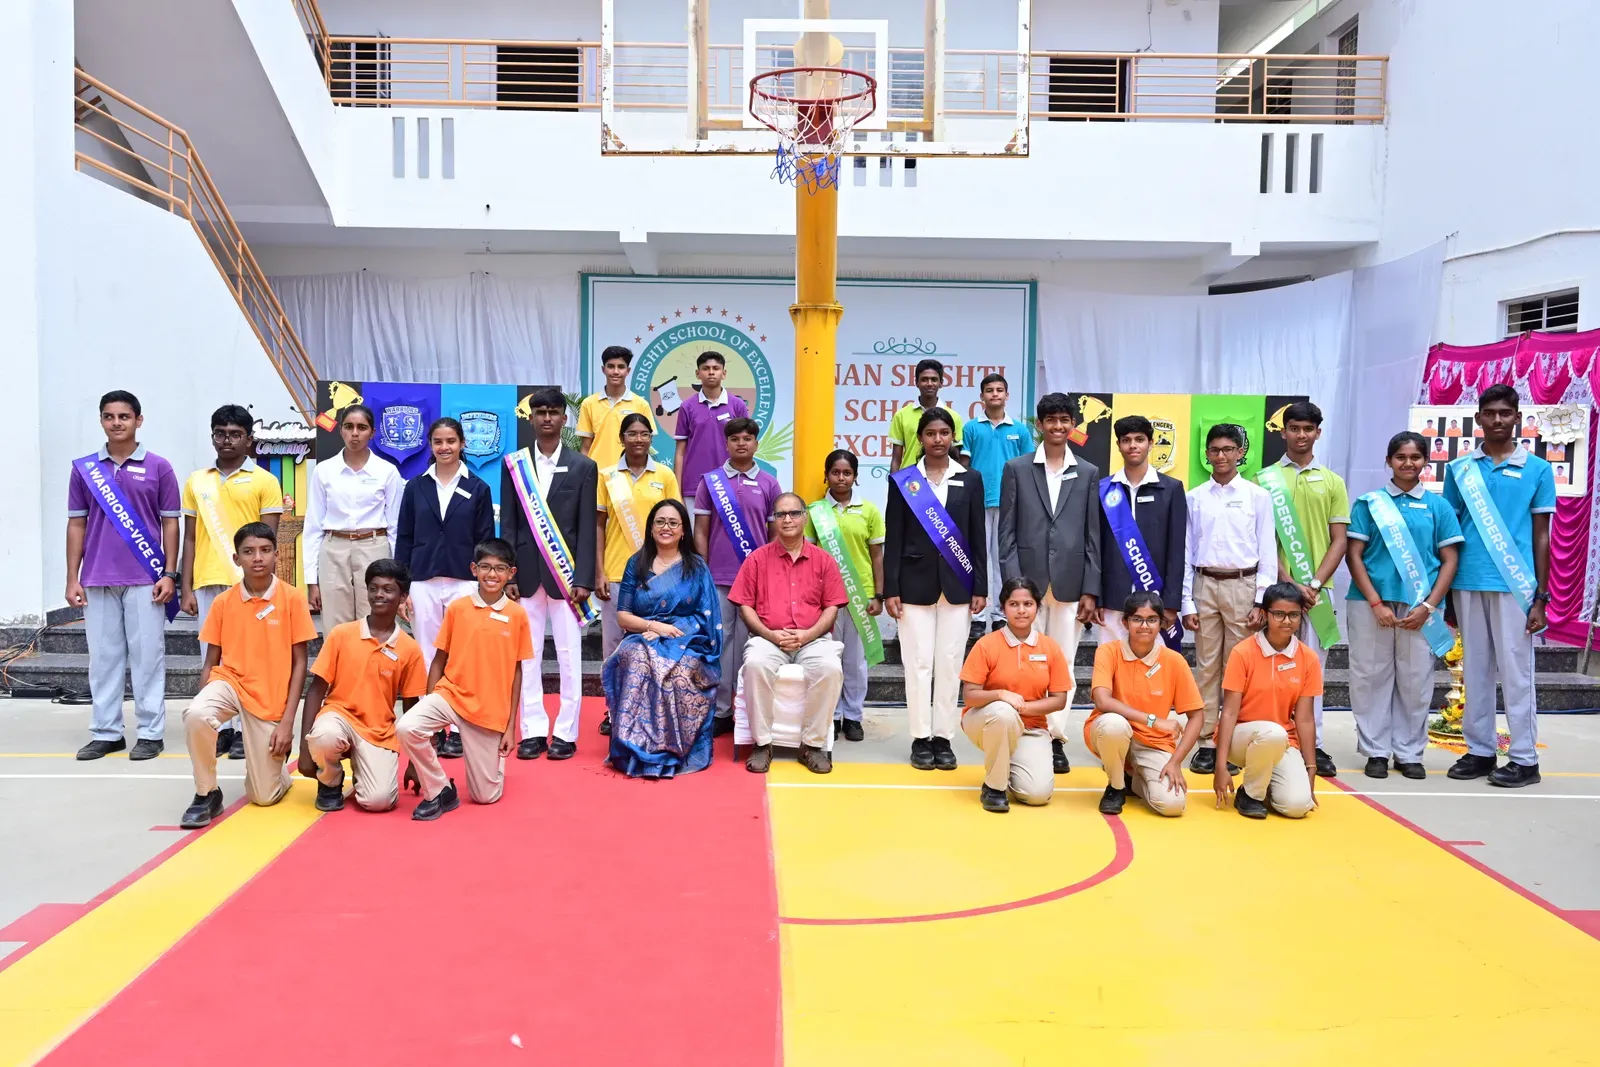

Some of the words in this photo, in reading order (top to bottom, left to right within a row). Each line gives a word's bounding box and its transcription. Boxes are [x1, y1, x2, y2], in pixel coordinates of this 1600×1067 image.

[635, 339, 669, 391] SRISHTI
[669, 325, 727, 344] SCHOOL
[730, 335, 750, 351] OF
[90, 467, 154, 558] WARRIORS-VICE
[150, 558, 165, 579] CA
[925, 506, 950, 539] SCHOOL
[945, 535, 973, 574] PRESIDENT
[1125, 537, 1155, 591] SCHOOL
[851, 595, 876, 643] CAPTAIN
